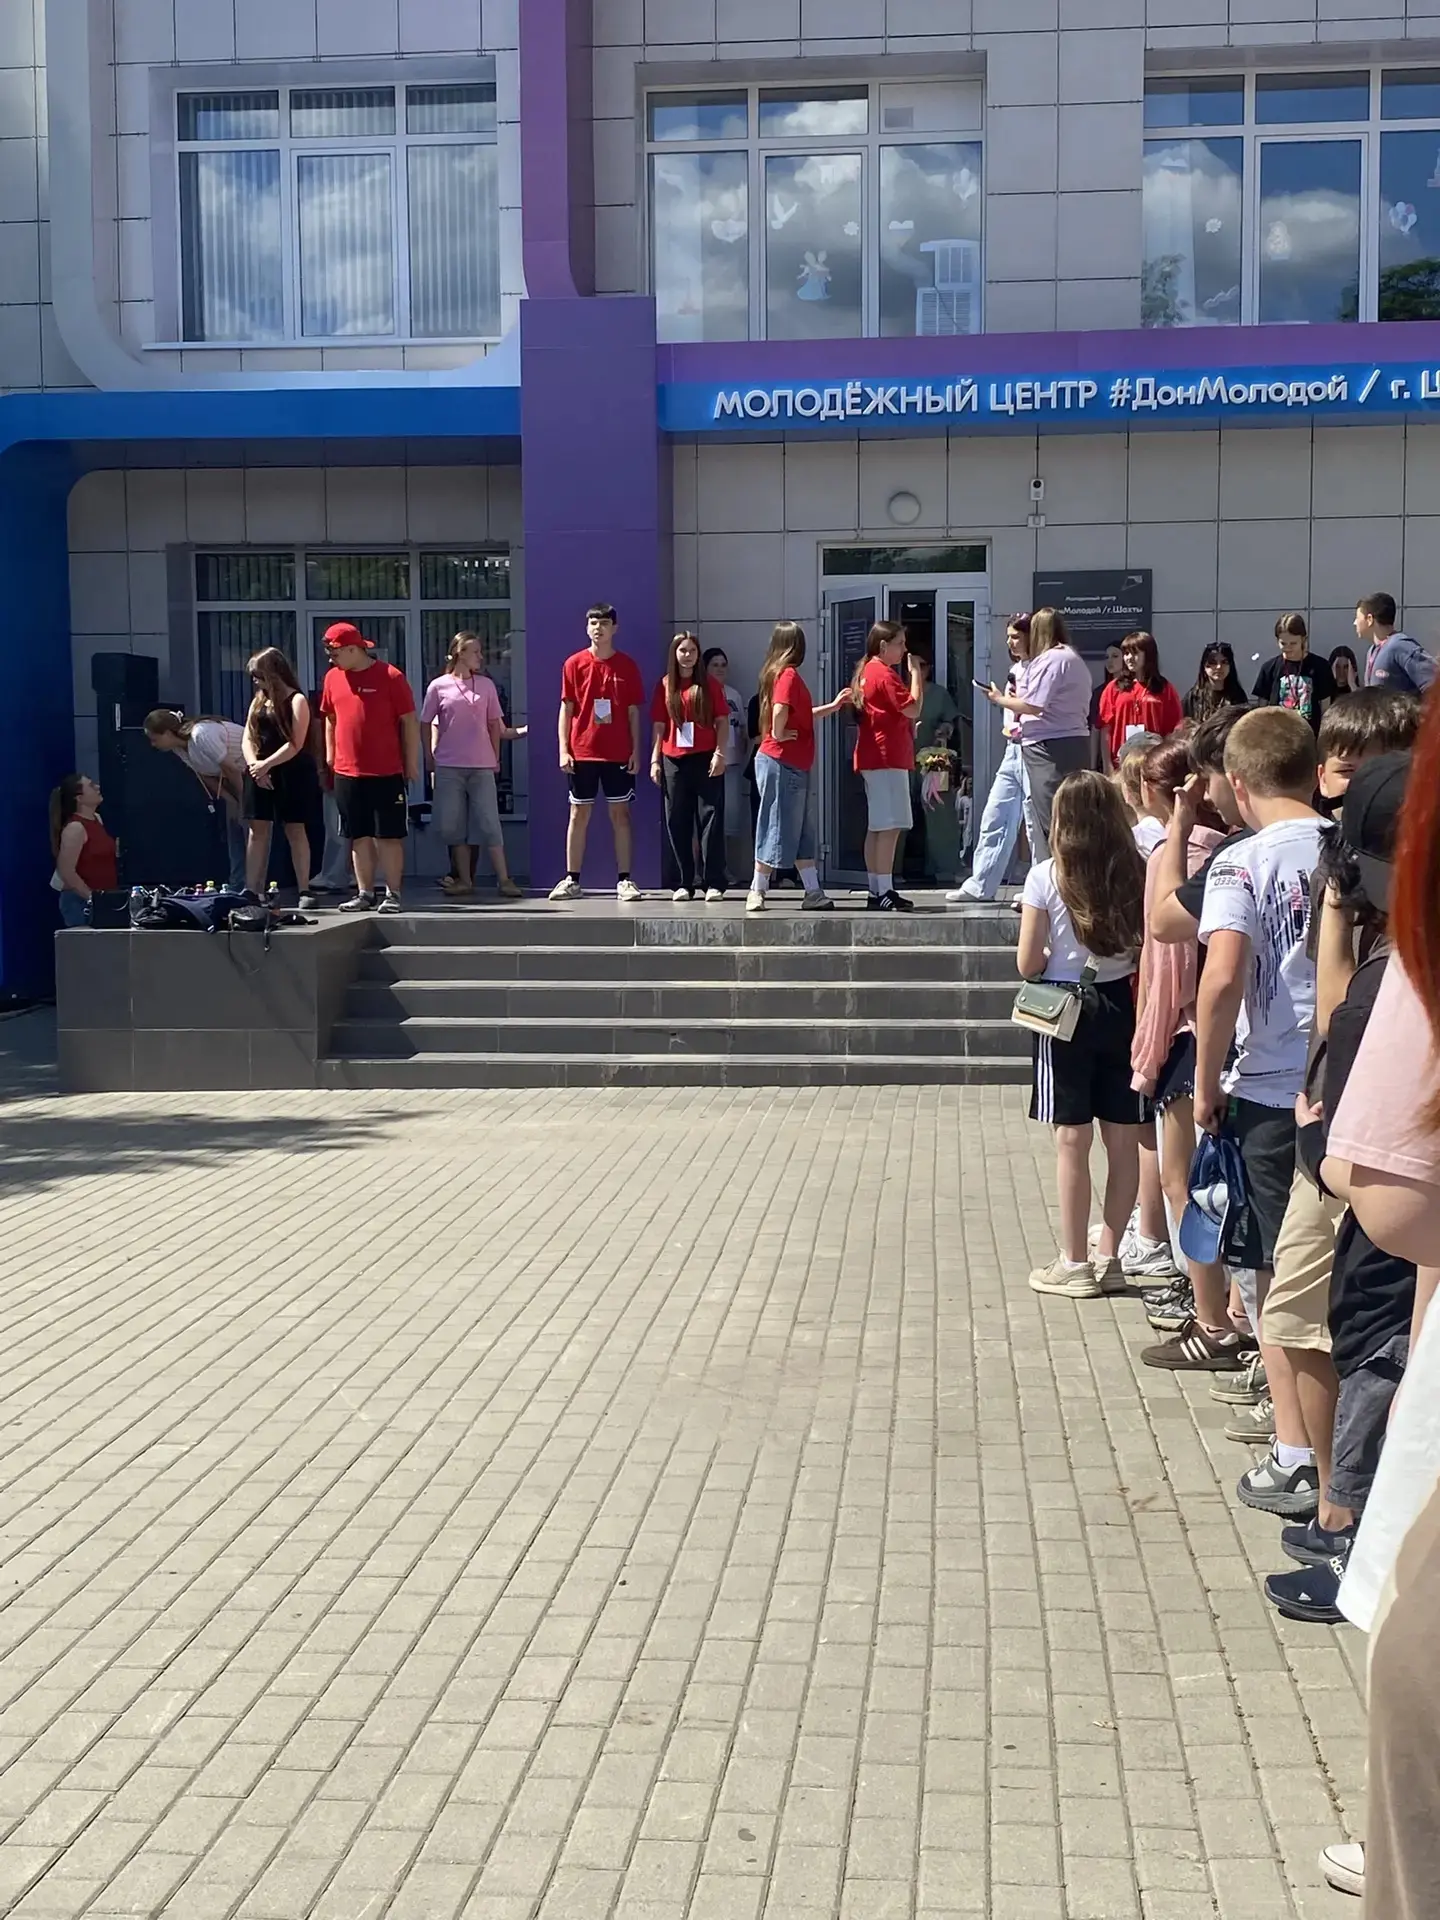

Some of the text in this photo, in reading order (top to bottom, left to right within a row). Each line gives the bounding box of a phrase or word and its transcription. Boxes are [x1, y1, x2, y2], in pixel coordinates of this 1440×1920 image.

[713, 378, 978, 421] МОЛОДЁЖНЫЙ
[989, 380, 1098, 416] ЦЕНТР
[1109, 374, 1348, 411] #ДонМолодой
[1390, 378, 1411, 400] г.
